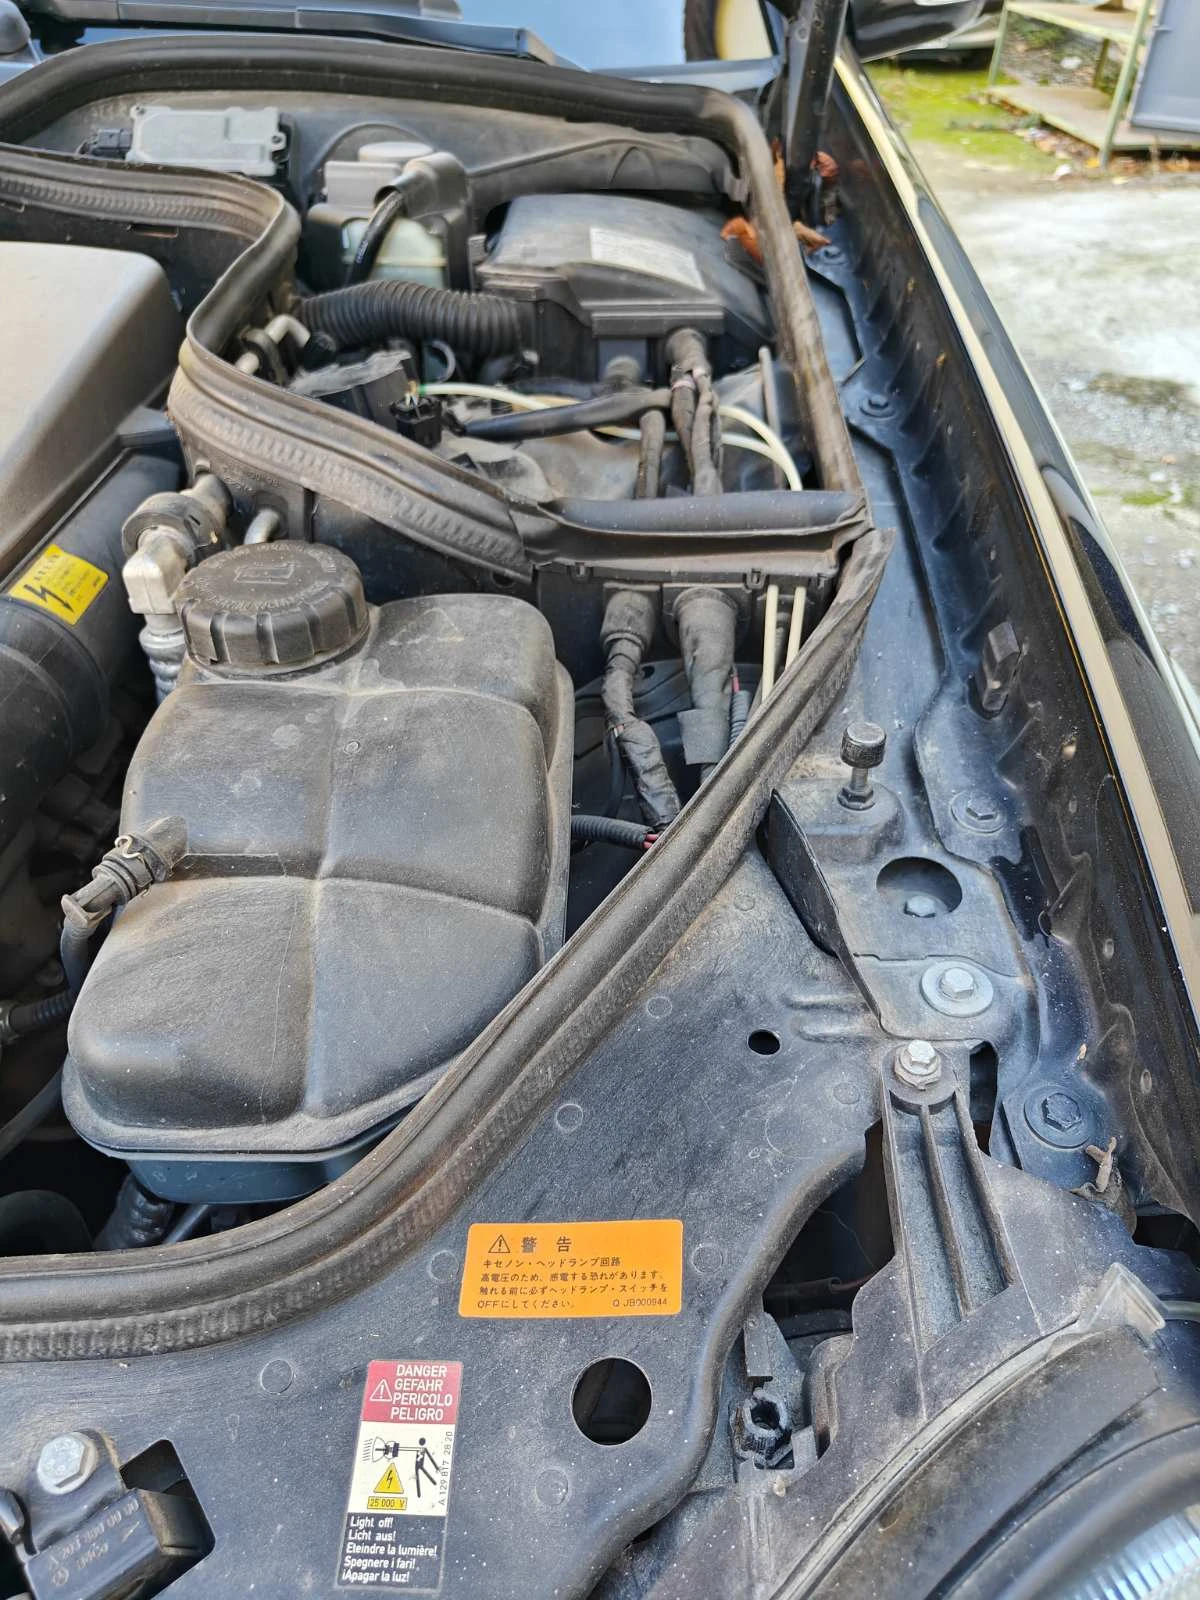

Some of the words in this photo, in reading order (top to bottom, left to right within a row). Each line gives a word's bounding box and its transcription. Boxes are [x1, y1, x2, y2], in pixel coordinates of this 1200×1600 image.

[396, 1364, 448, 1377] DANGER
[394, 1378, 444, 1391] GEFAHR
[392, 1392, 453, 1407] PERICOLO
[390, 1407, 444, 1421] PELIGRO
[370, 1498, 380, 1507] 25
[381, 1499, 395, 1508] 000
[350, 1516, 374, 1529] Light
[378, 1517, 394, 1528] off!
[348, 1529, 372, 1540] Licht
[375, 1531, 396, 1541] aus!
[346, 1542, 385, 1554] Eteindre
[387, 1544, 396, 1555] la
[398, 1544, 437, 1557] lumière!
[344, 1555, 389, 1570] Spegnere
[391, 1557, 395, 1568] i
[396, 1557, 416, 1569] fari!
[381, 1571, 390, 1582] la
[392, 1571, 410, 1582] luz!
